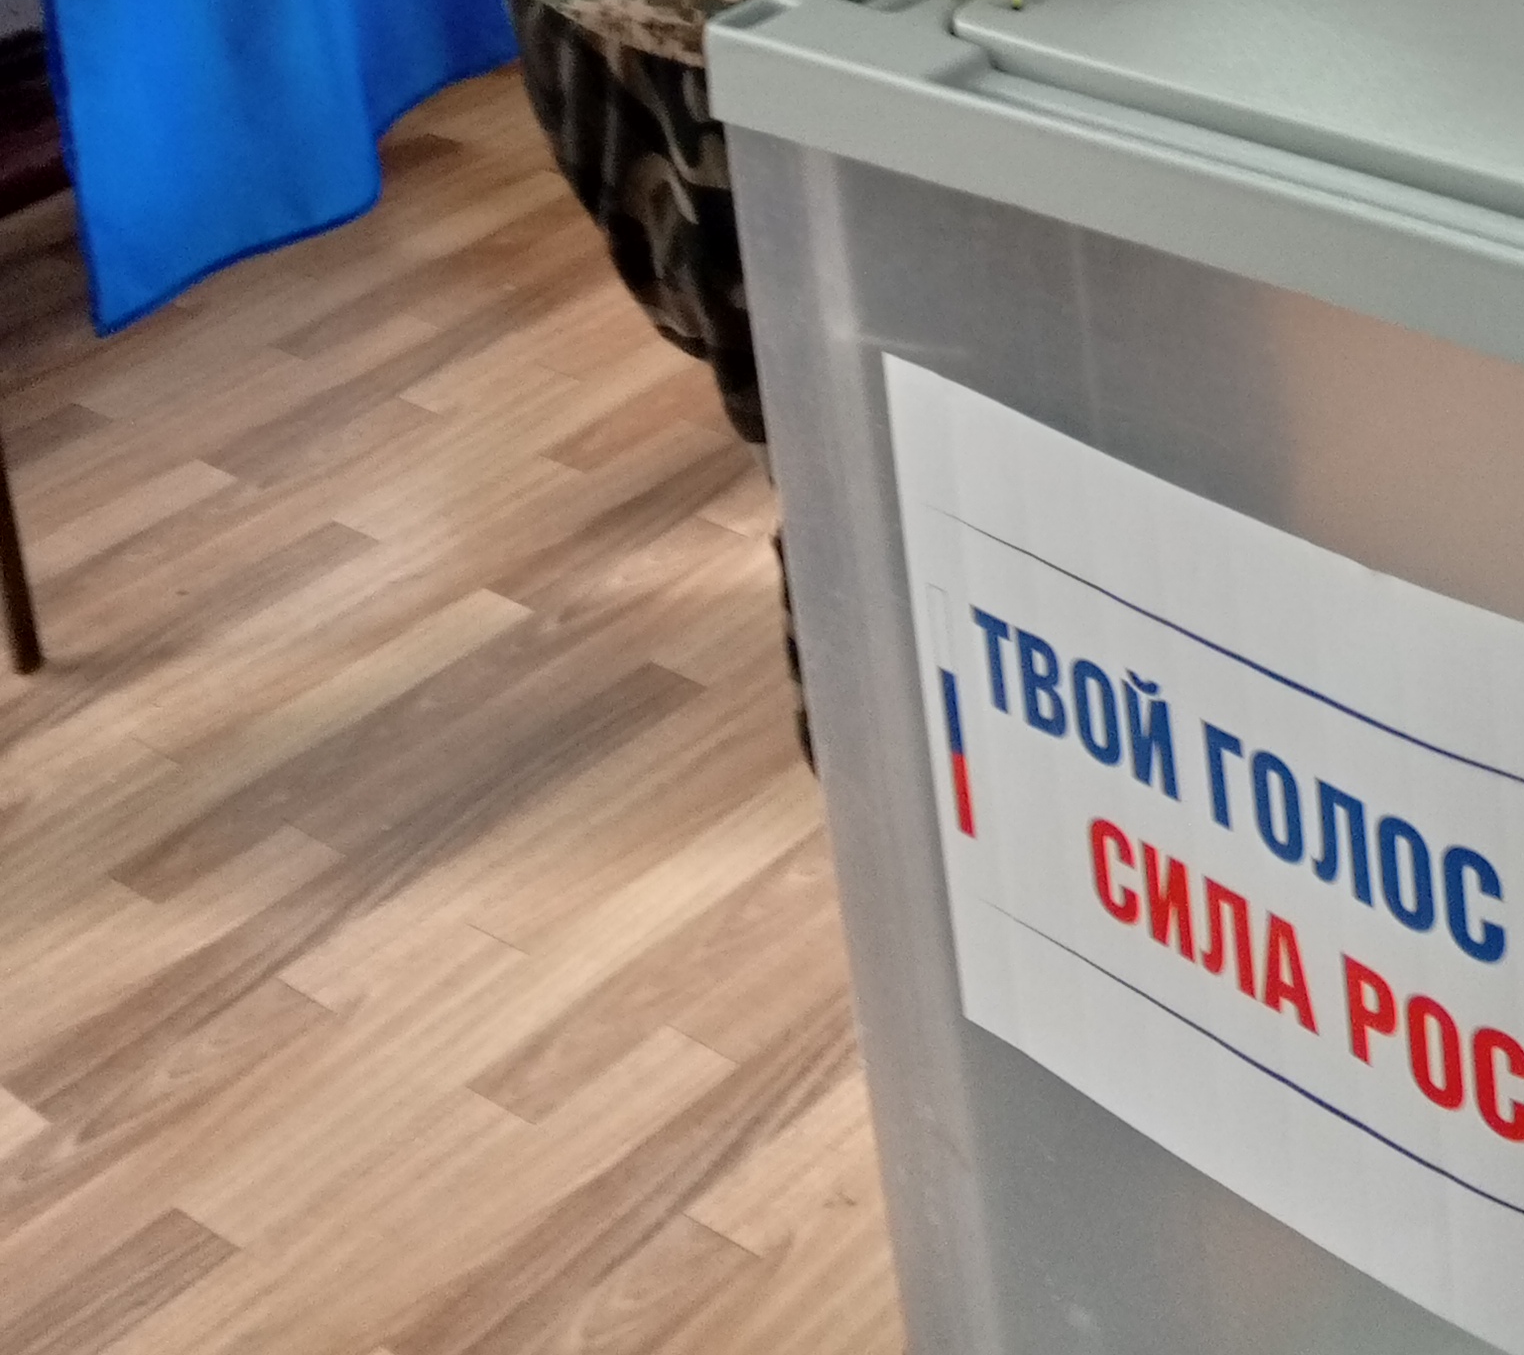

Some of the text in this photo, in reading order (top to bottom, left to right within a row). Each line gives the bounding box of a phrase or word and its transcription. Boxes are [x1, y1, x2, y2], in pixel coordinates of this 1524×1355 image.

[970, 605, 1182, 803] ТВОЙ
[1201, 720, 1507, 965] ГОЛОС
[1088, 817, 1320, 1036] СИЛА
